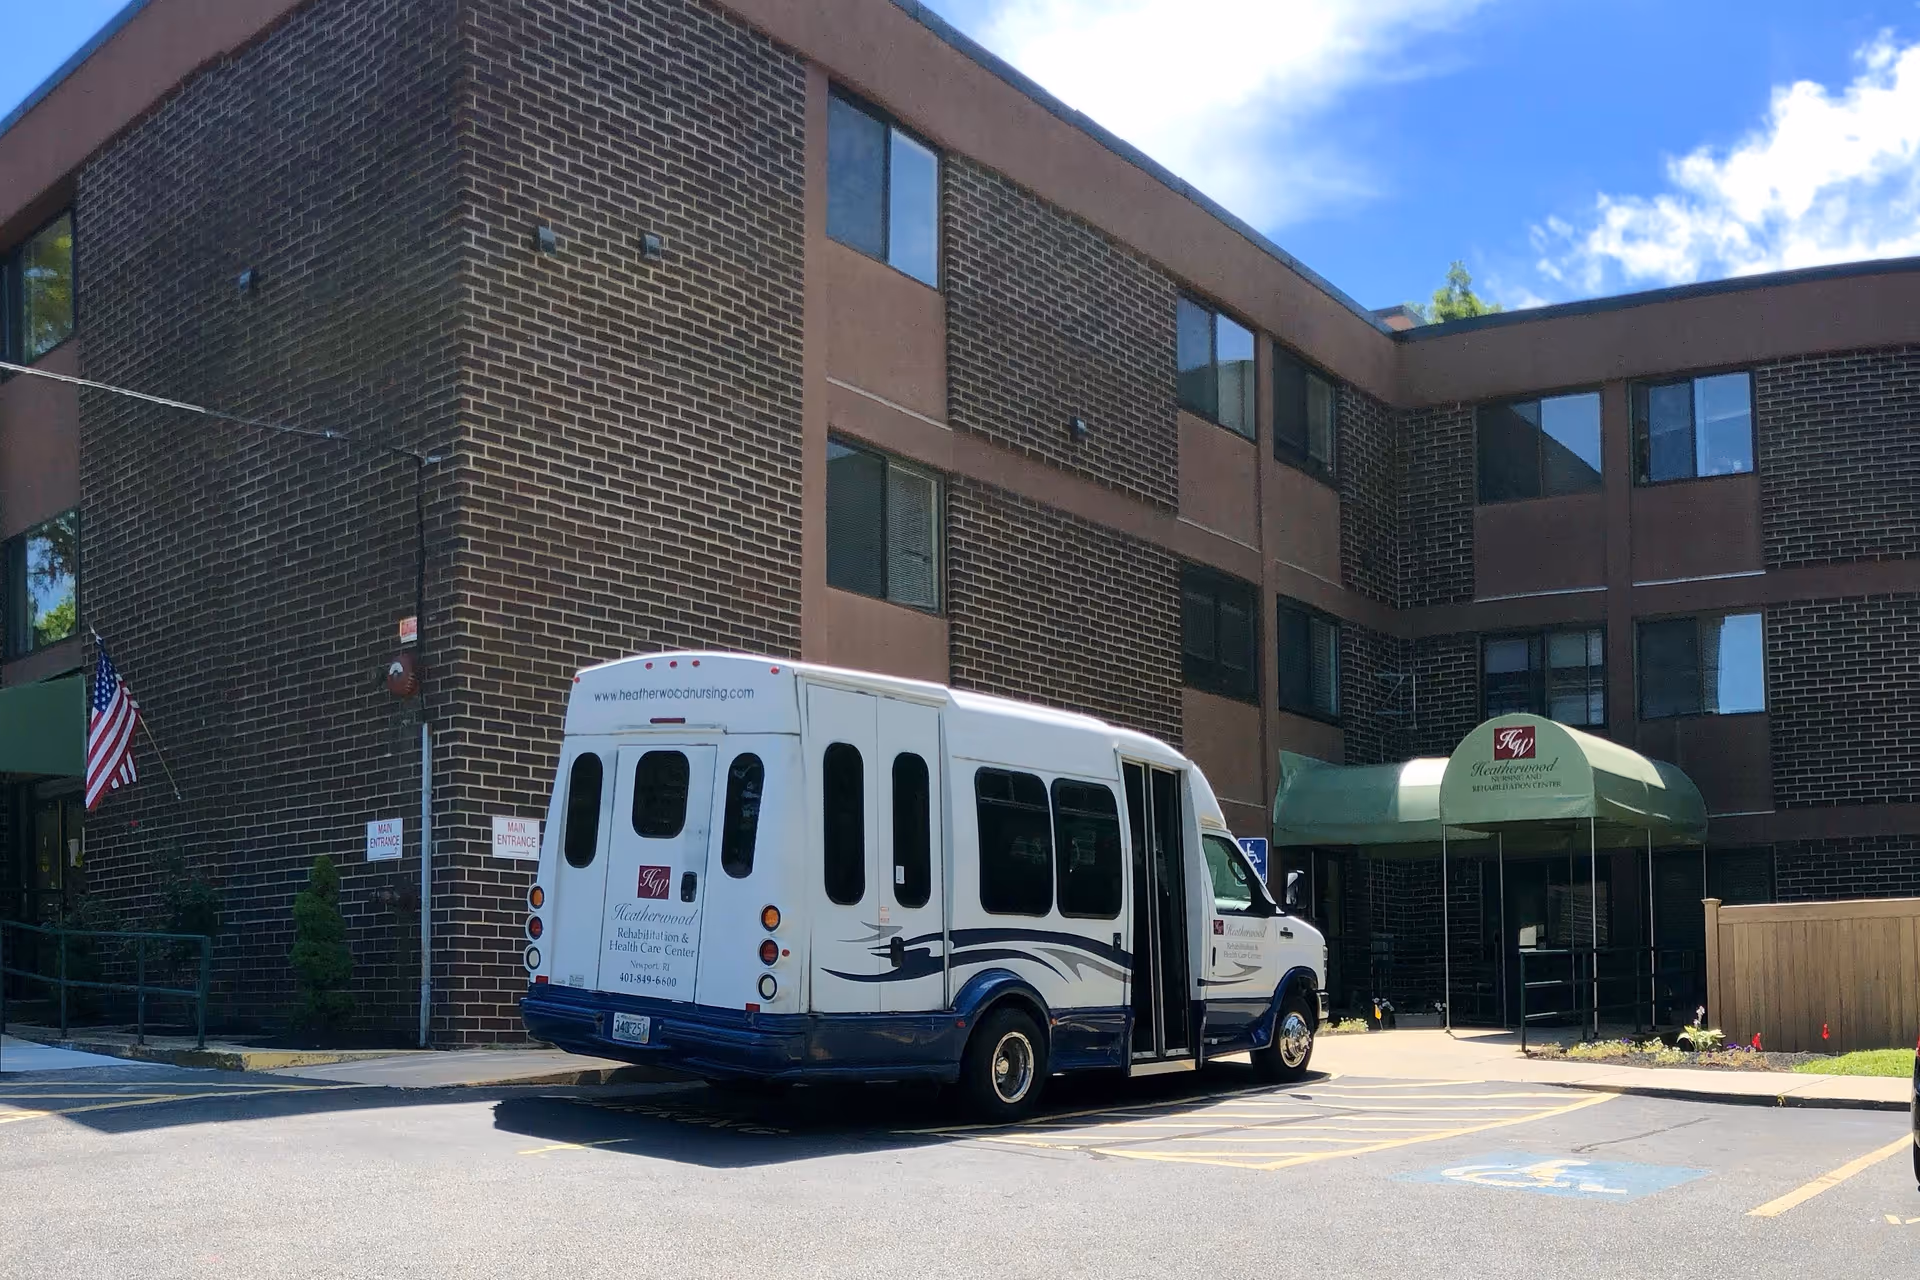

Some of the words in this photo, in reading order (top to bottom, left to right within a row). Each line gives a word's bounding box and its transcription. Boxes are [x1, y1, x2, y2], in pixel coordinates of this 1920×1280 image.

[594, 686, 755, 702] www.heatherwoodnursing.com
[1470, 757, 1559, 778] Heatherwood
[1491, 774, 1524, 783] NURSING
[1526, 773, 1542, 781] AND
[1472, 782, 1531, 792] REHABILITATION
[1533, 780, 1562, 790] CENTER
[377, 822, 393, 834] MAIN
[507, 821, 526, 833] MAIN
[370, 834, 400, 848] ENTRANCE
[497, 834, 536, 848] ENTRANCE
[610, 902, 699, 926] Heatherwood
[617, 927, 680, 943] Rehabilitation
[681, 932, 689, 944] &
[609, 939, 638, 953] Health
[640, 942, 662, 954] Care
[664, 944, 696, 958] Center
[661, 962, 671, 972] RI
[619, 972, 677, 988] 401-849-6600
